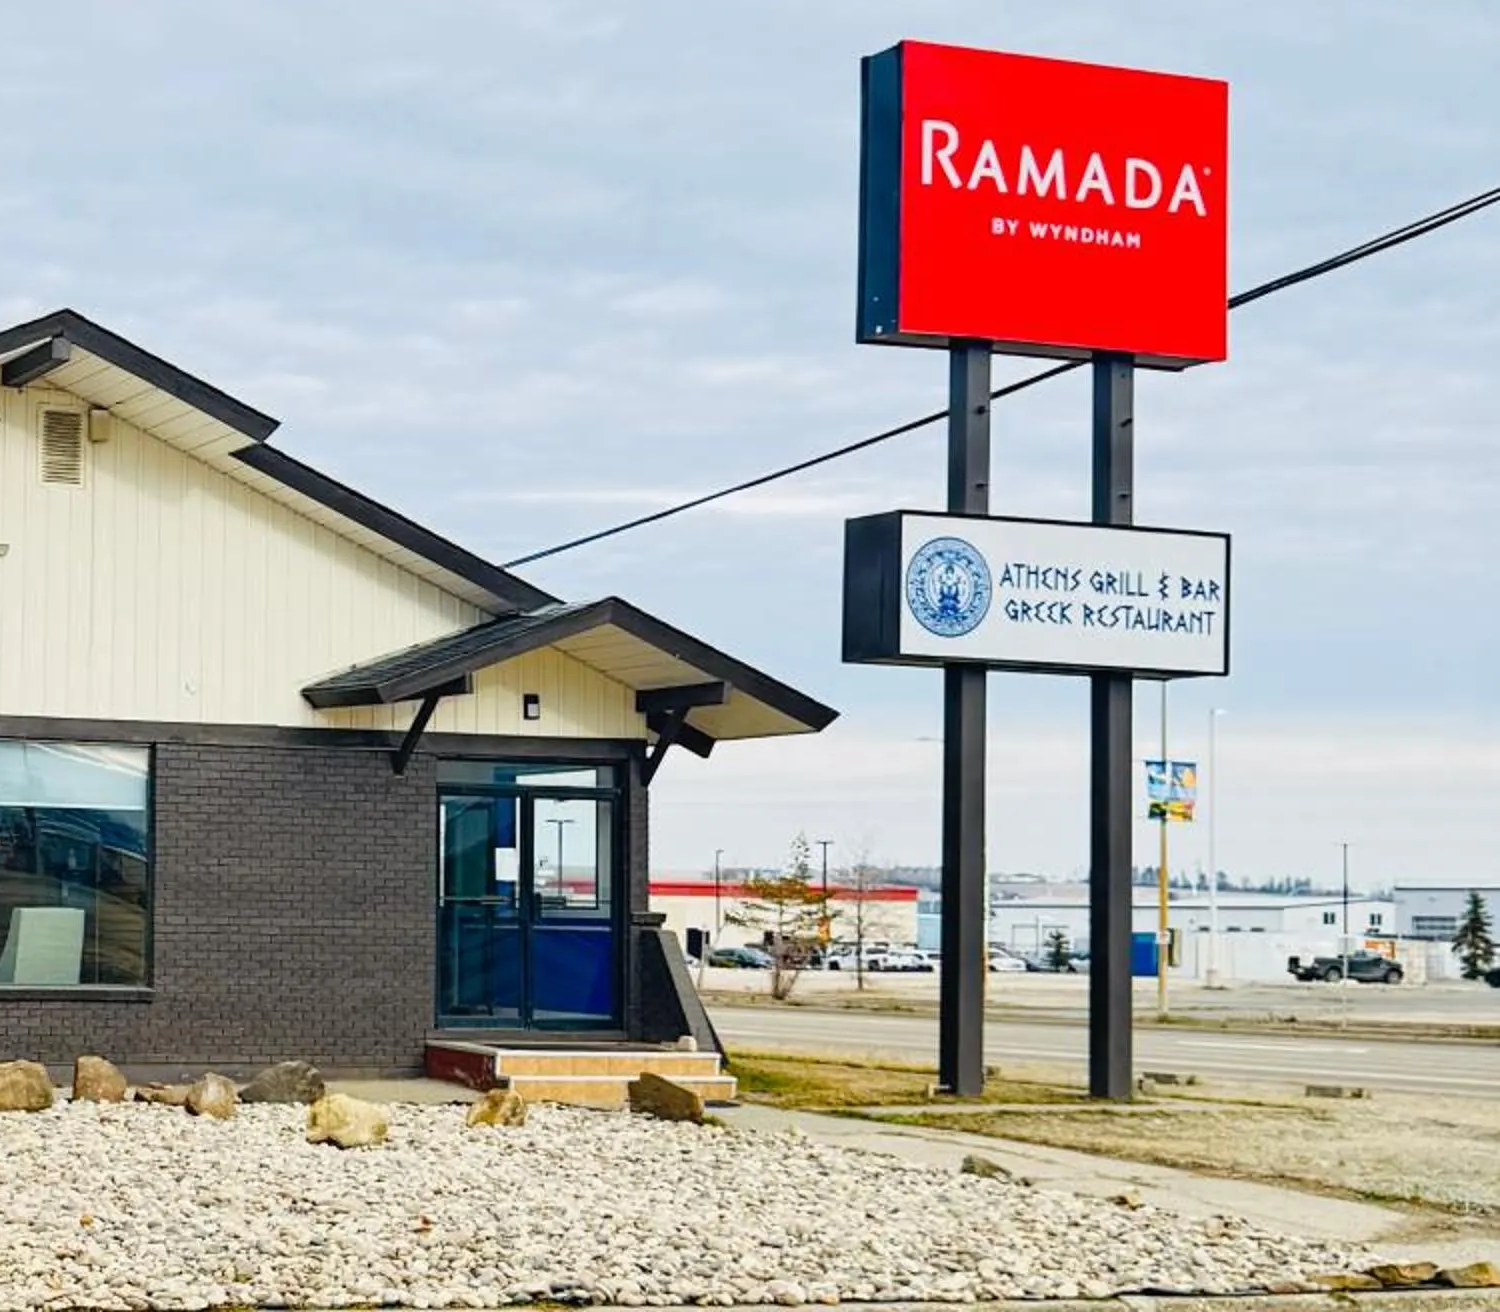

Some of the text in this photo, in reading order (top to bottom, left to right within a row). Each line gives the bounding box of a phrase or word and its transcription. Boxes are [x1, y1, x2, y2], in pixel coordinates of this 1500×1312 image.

[920, 119, 1207, 217] RAMADA
[991, 217, 1142, 248] BY WYNDHAM
[999, 562, 1082, 591] ATHENS
[1089, 570, 1149, 597] GRILL
[1180, 575, 1221, 602] BAR
[1003, 598, 1216, 636] GREEK RESTAURANT
